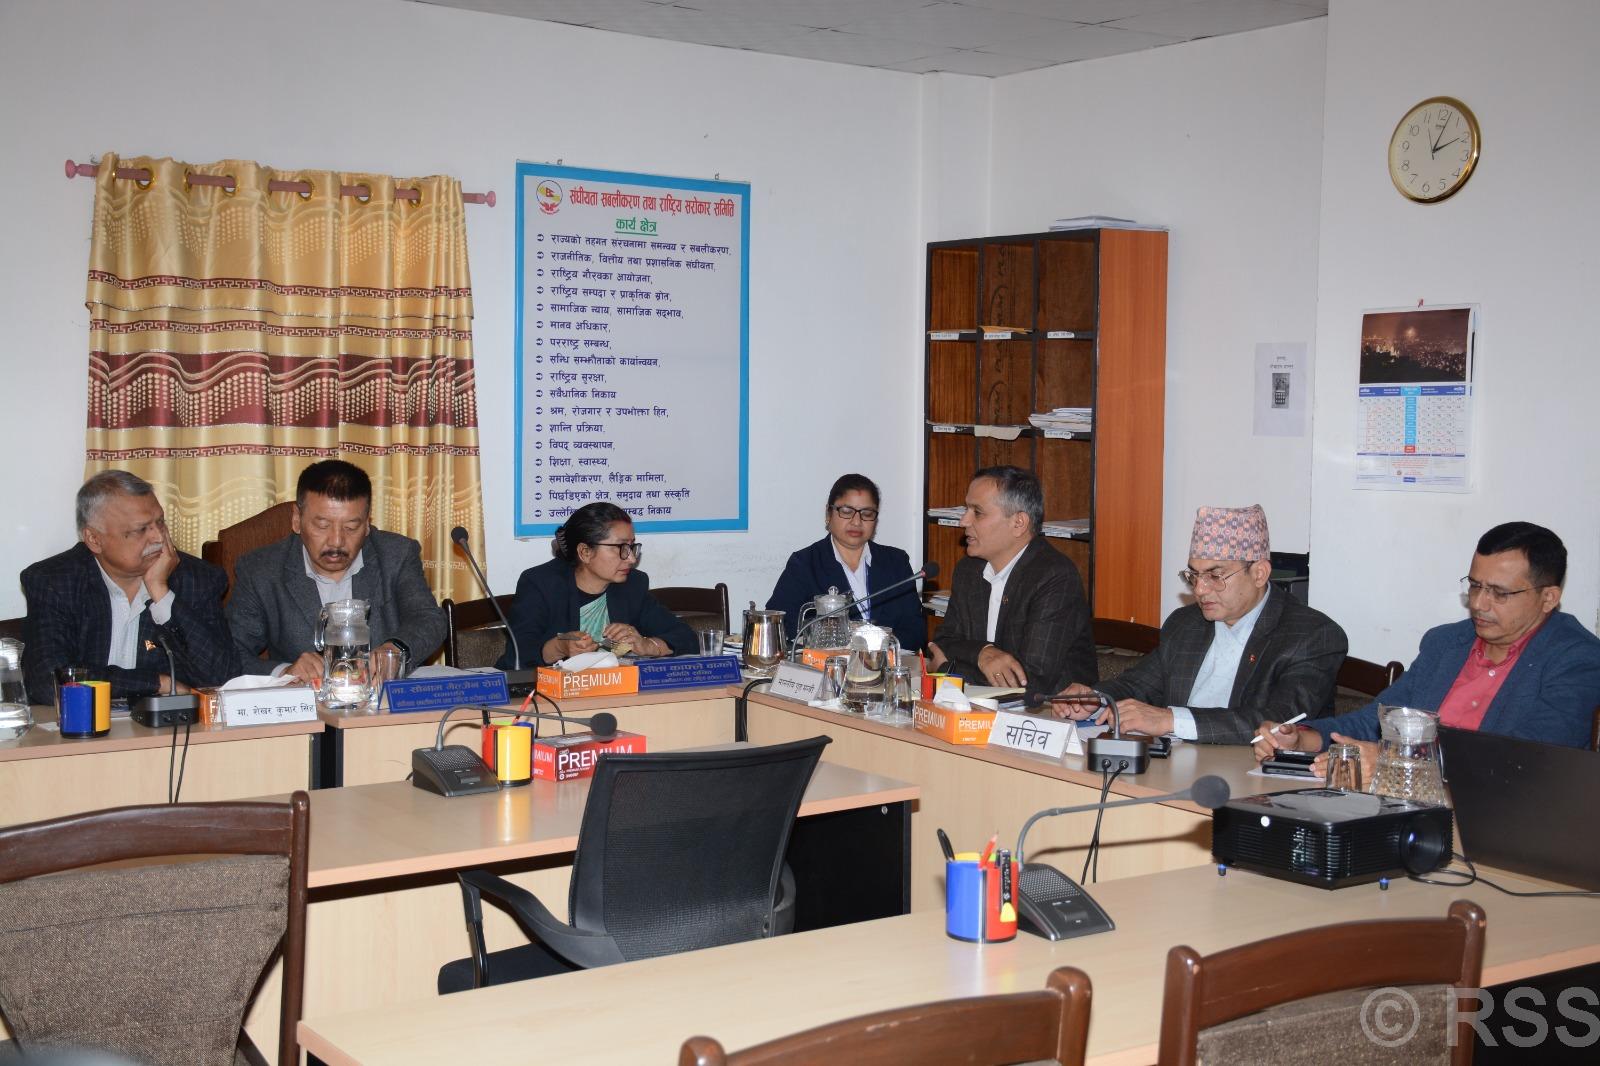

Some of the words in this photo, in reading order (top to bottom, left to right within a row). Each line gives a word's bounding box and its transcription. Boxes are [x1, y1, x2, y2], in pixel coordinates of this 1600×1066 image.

[563, 671, 622, 689] PREMIUM
[275, 704, 298, 717] कुमार
[914, 705, 946, 729] PREMIUM
[959, 719, 994, 730] PREMIU
[1005, 719, 1052, 750] सचिव
